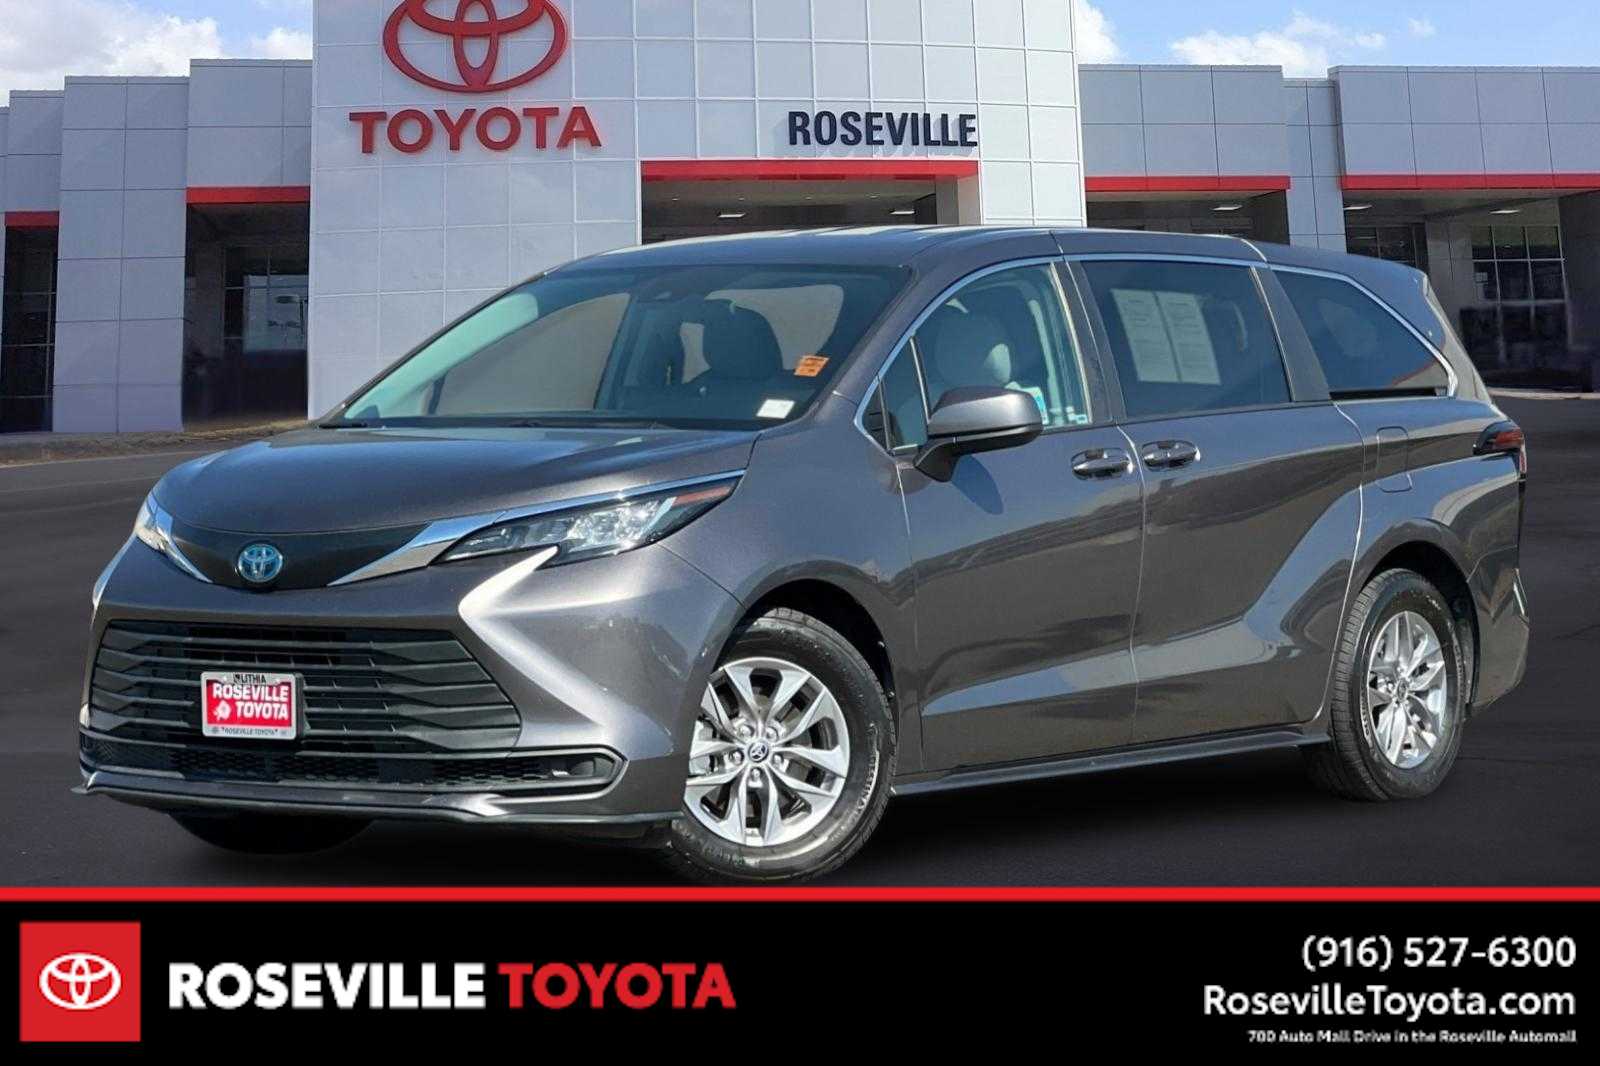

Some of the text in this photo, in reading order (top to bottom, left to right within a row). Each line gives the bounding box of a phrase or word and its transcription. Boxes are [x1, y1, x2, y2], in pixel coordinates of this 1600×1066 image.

[349, 106, 602, 154] TOYOTA
[788, 110, 978, 147] ROSEVILLE
[212, 683, 290, 702] ROSEVILLE
[235, 701, 289, 720] TOYOTA
